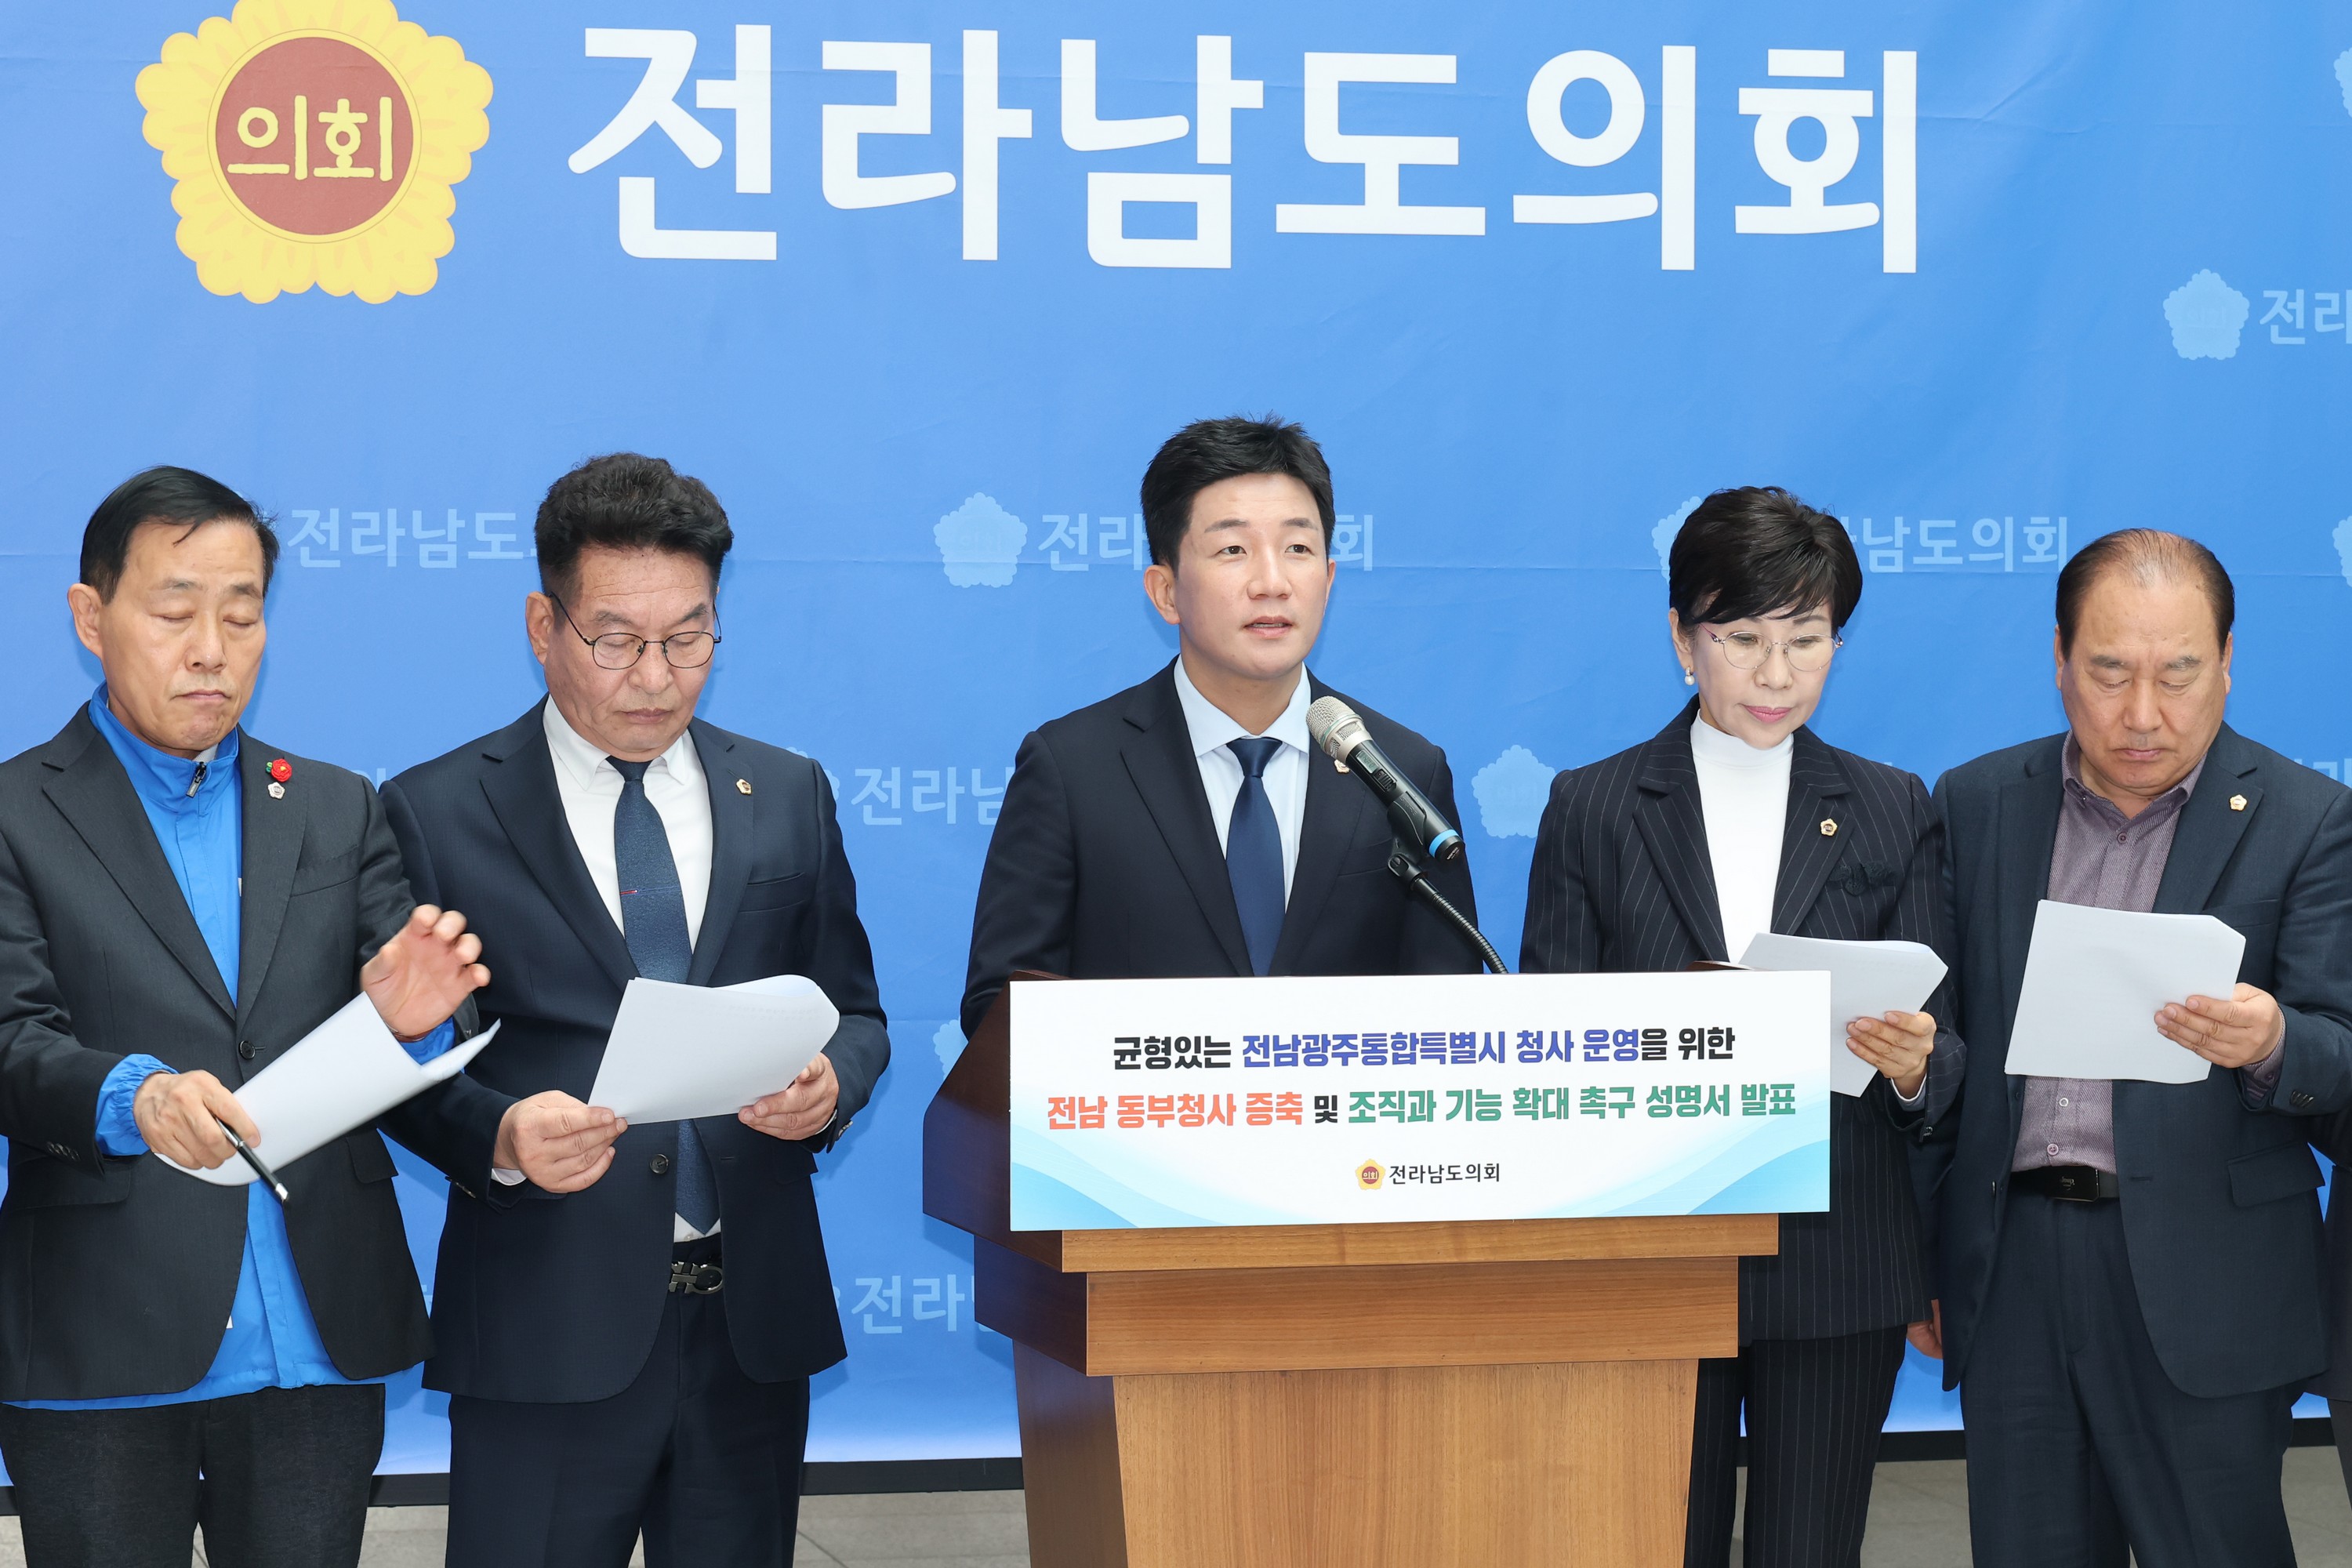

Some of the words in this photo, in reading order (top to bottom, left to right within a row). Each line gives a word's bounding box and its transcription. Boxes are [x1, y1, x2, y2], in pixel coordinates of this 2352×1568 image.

[227, 95, 393, 181] 의회
[568, 24, 1917, 274] 전라남도의회
[287, 508, 537, 568] 전라남도
[1113, 1035, 1232, 1070] 균형있는
[1242, 1030, 1506, 1068] 전남광주통합특별시
[1516, 1029, 1574, 1064] 청사
[1582, 1028, 1668, 1062] 운영을
[1678, 1026, 1736, 1061] 위한
[1047, 1095, 1108, 1130] 전남
[1116, 1093, 1237, 1128] 동부청사
[1245, 1091, 1304, 1126] 증축
[1313, 1094, 1338, 1123] 및
[1348, 1089, 1437, 1123] 조직과
[1445, 1088, 1503, 1122] 기능
[1512, 1087, 1570, 1120] 확대
[1579, 1086, 1636, 1119] 촉구
[1646, 1083, 1730, 1118] 성명서
[1740, 1083, 1796, 1116] 발표
[1363, 1171, 1378, 1181] 의회
[1389, 1163, 1500, 1185] 전라남도의회
